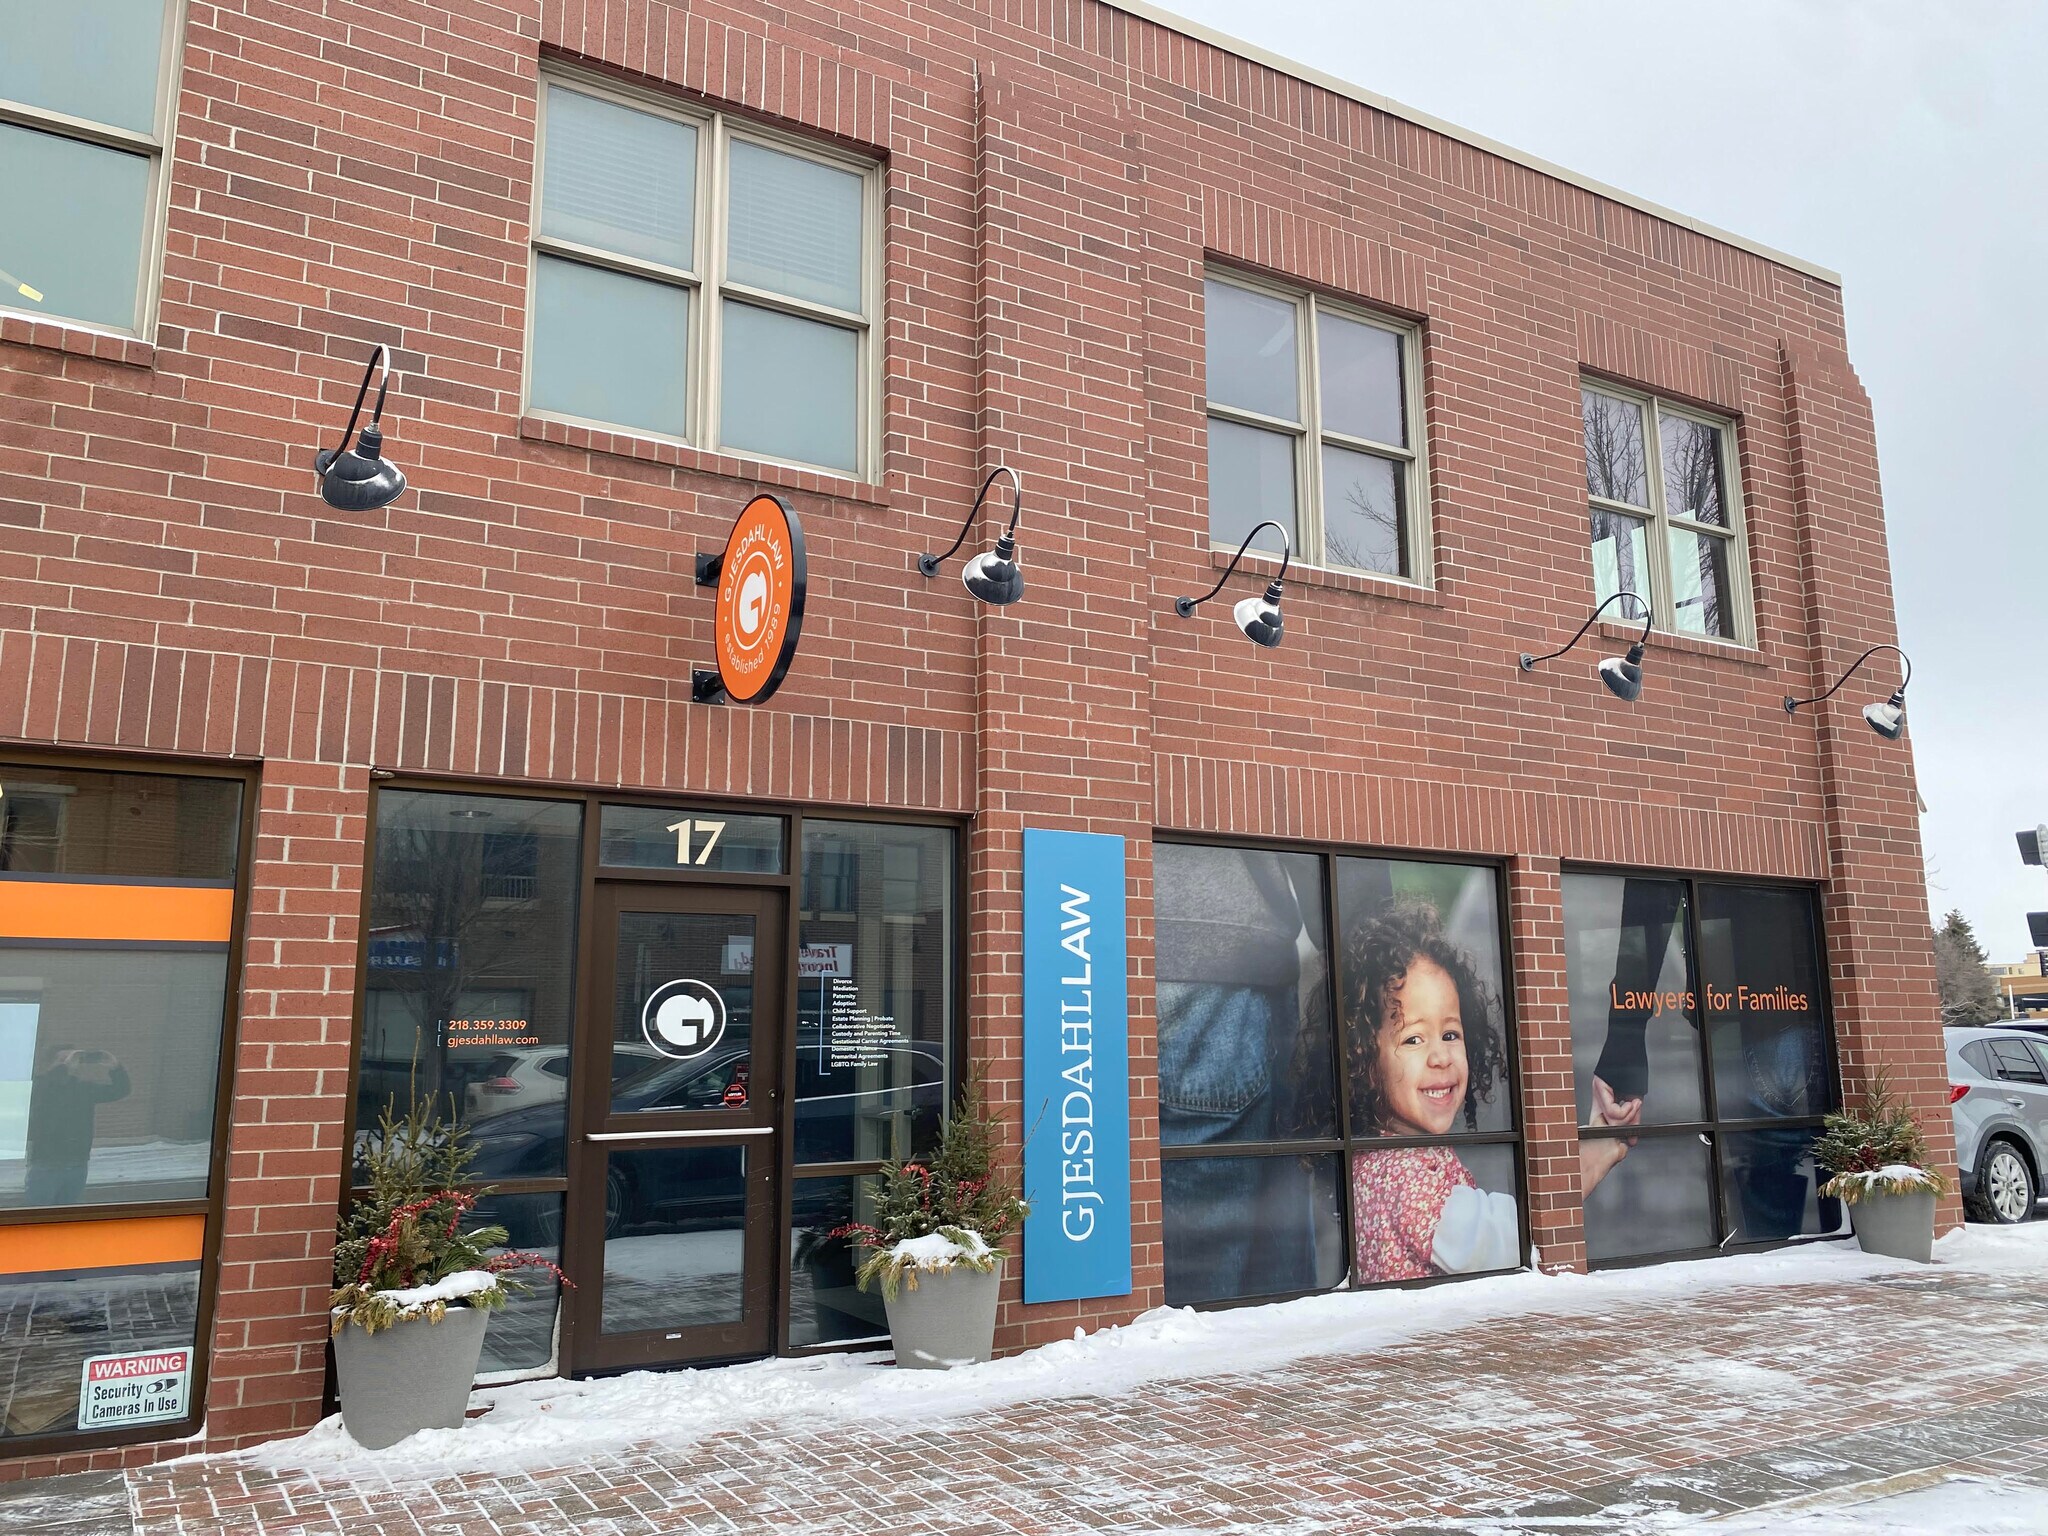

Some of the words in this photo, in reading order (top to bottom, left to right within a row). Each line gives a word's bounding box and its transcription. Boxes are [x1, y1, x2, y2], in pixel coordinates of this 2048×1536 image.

[725, 524, 766, 602] GJESDAHL
[767, 528, 784, 570] LAW
[724, 633, 765, 675] established
[764, 602, 781, 650] 1989
[665, 818, 726, 865] 17
[1612, 983, 1696, 1018] Lawyers
[1706, 983, 1733, 1010] for
[1737, 985, 1808, 1011] Families
[448, 1020, 527, 1030] 218.359.3309
[447, 1034, 539, 1048] gjesdahllaw.com
[95, 1355, 182, 1379] WARNING
[94, 1383, 143, 1400] Security
[92, 1402, 140, 1419] Cameras
[144, 1399, 154, 1412] In
[158, 1397, 177, 1411] Use
